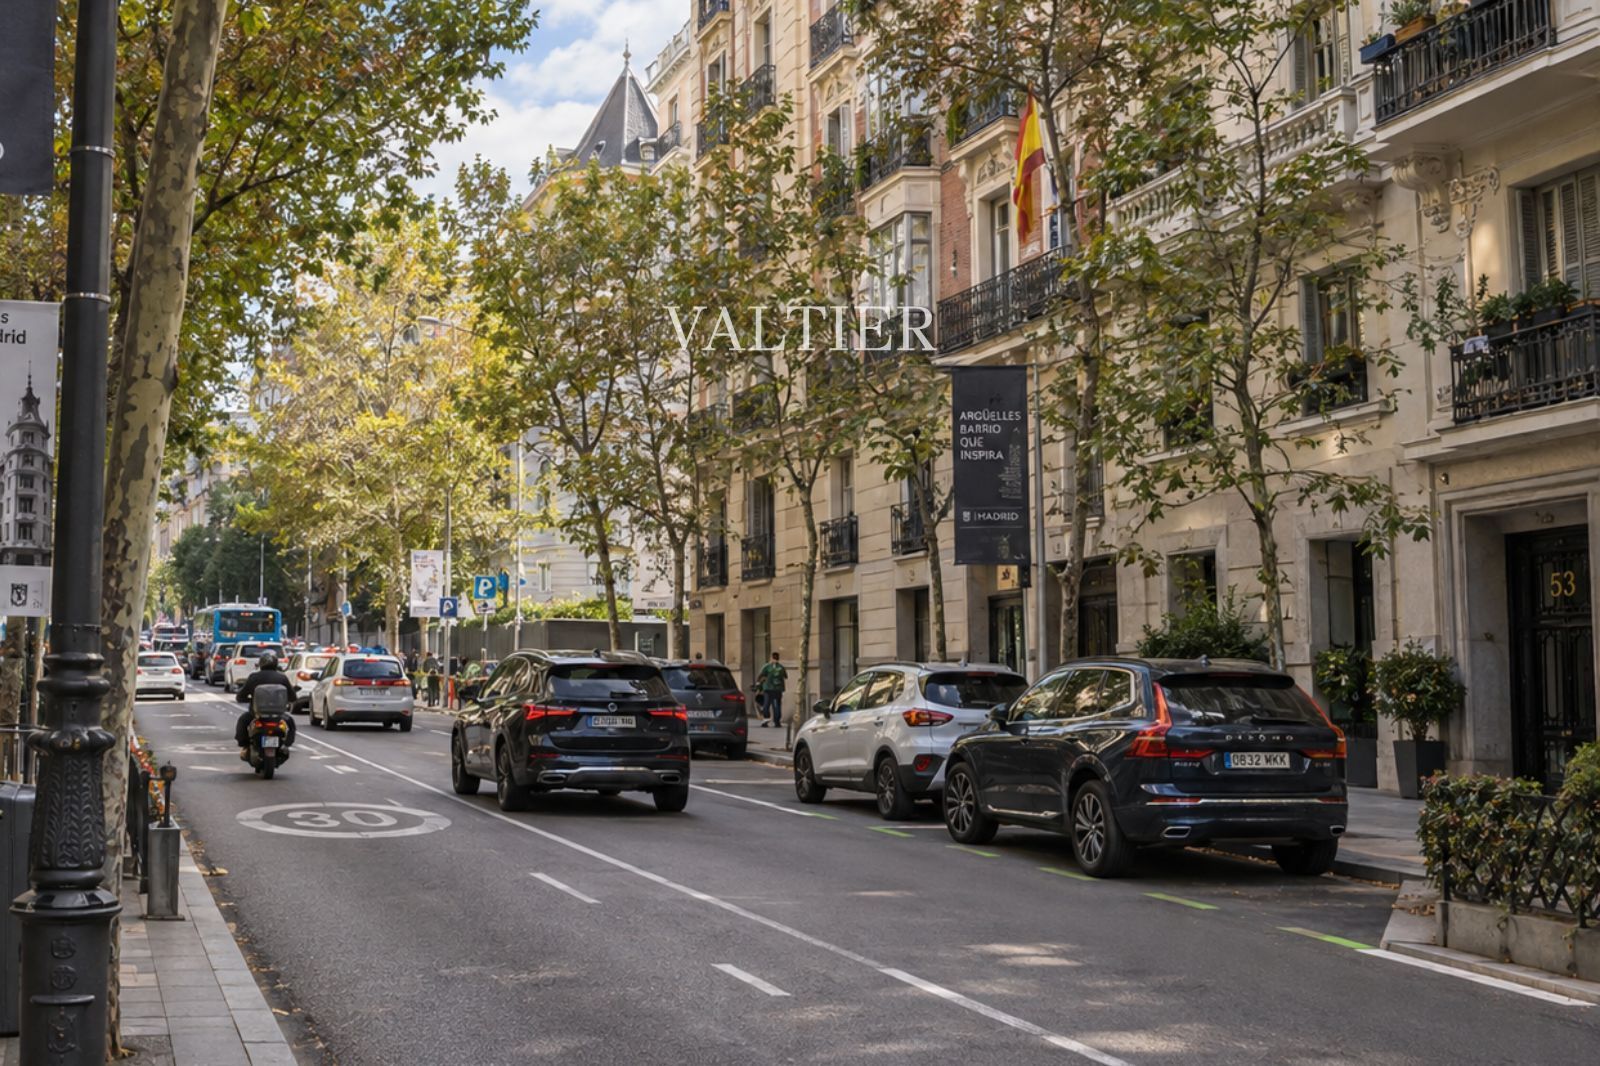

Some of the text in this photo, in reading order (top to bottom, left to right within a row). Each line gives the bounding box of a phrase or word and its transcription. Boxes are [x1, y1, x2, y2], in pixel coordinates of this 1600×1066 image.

[960, 424, 1001, 434] BARRIO
[960, 437, 984, 448] QUE
[961, 450, 1004, 460] INSPIRA
[978, 512, 1019, 521] MADRID
[1550, 570, 1576, 597] 53
[287, 810, 398, 828] 30
